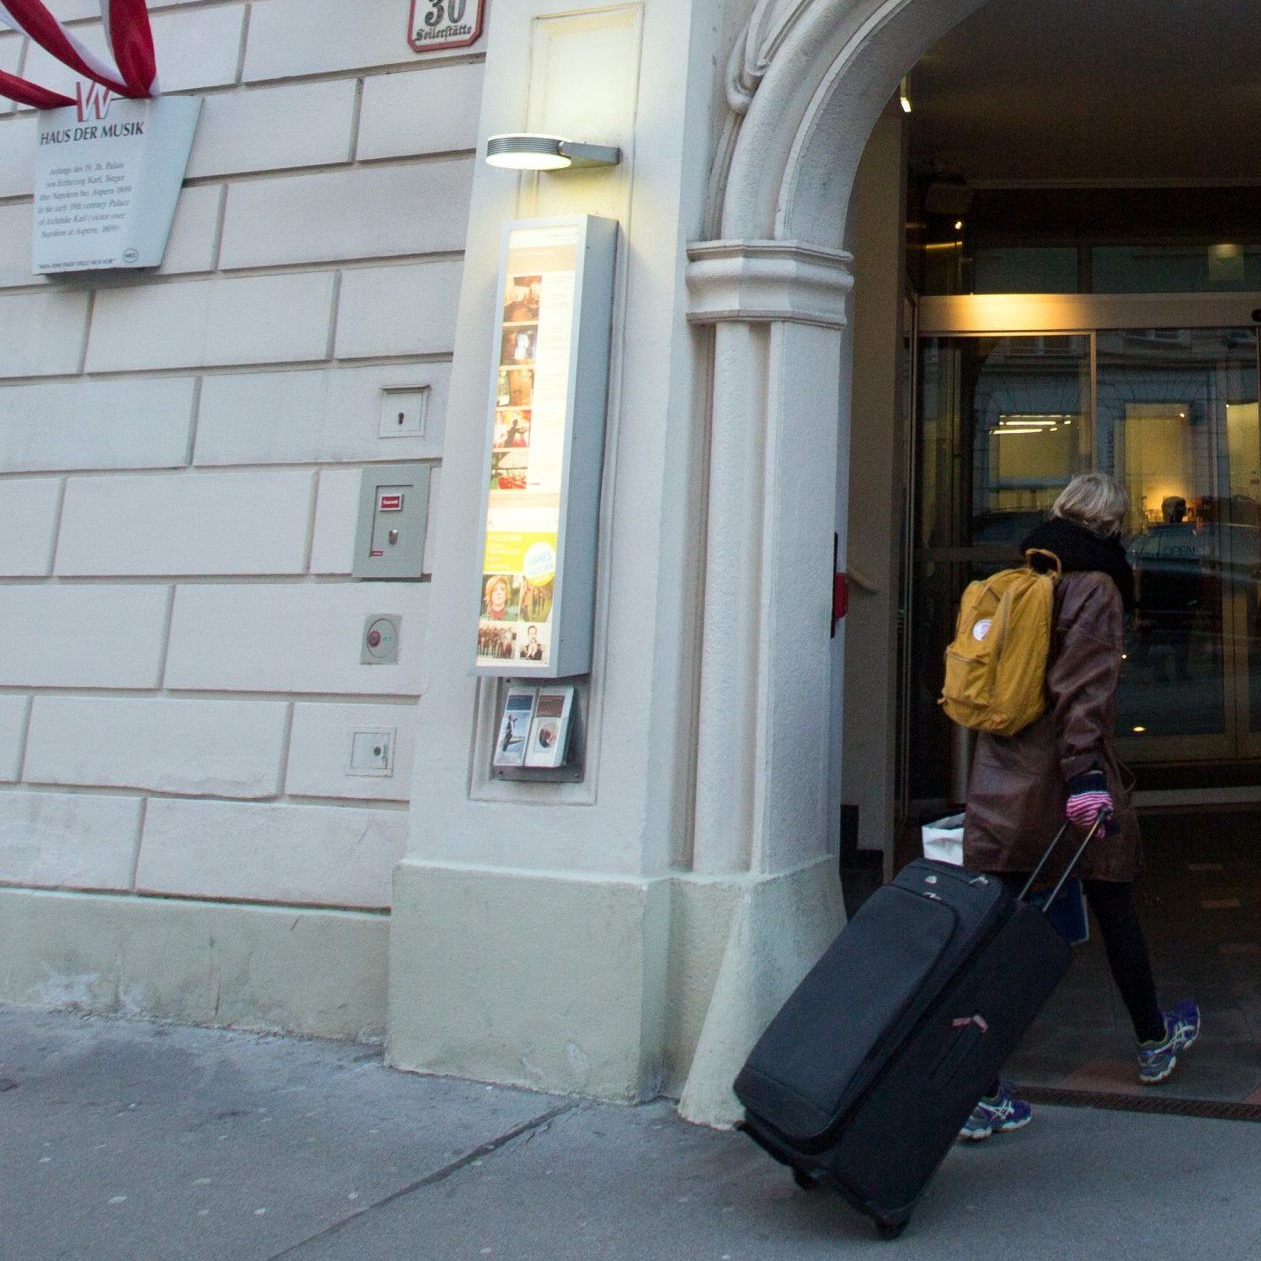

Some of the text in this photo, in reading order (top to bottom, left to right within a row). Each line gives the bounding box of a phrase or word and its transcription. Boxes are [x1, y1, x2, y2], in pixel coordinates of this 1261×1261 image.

[40, 121, 144, 145] HAUS DER MUSIK
[1163, 545, 1195, 556] OPEN
